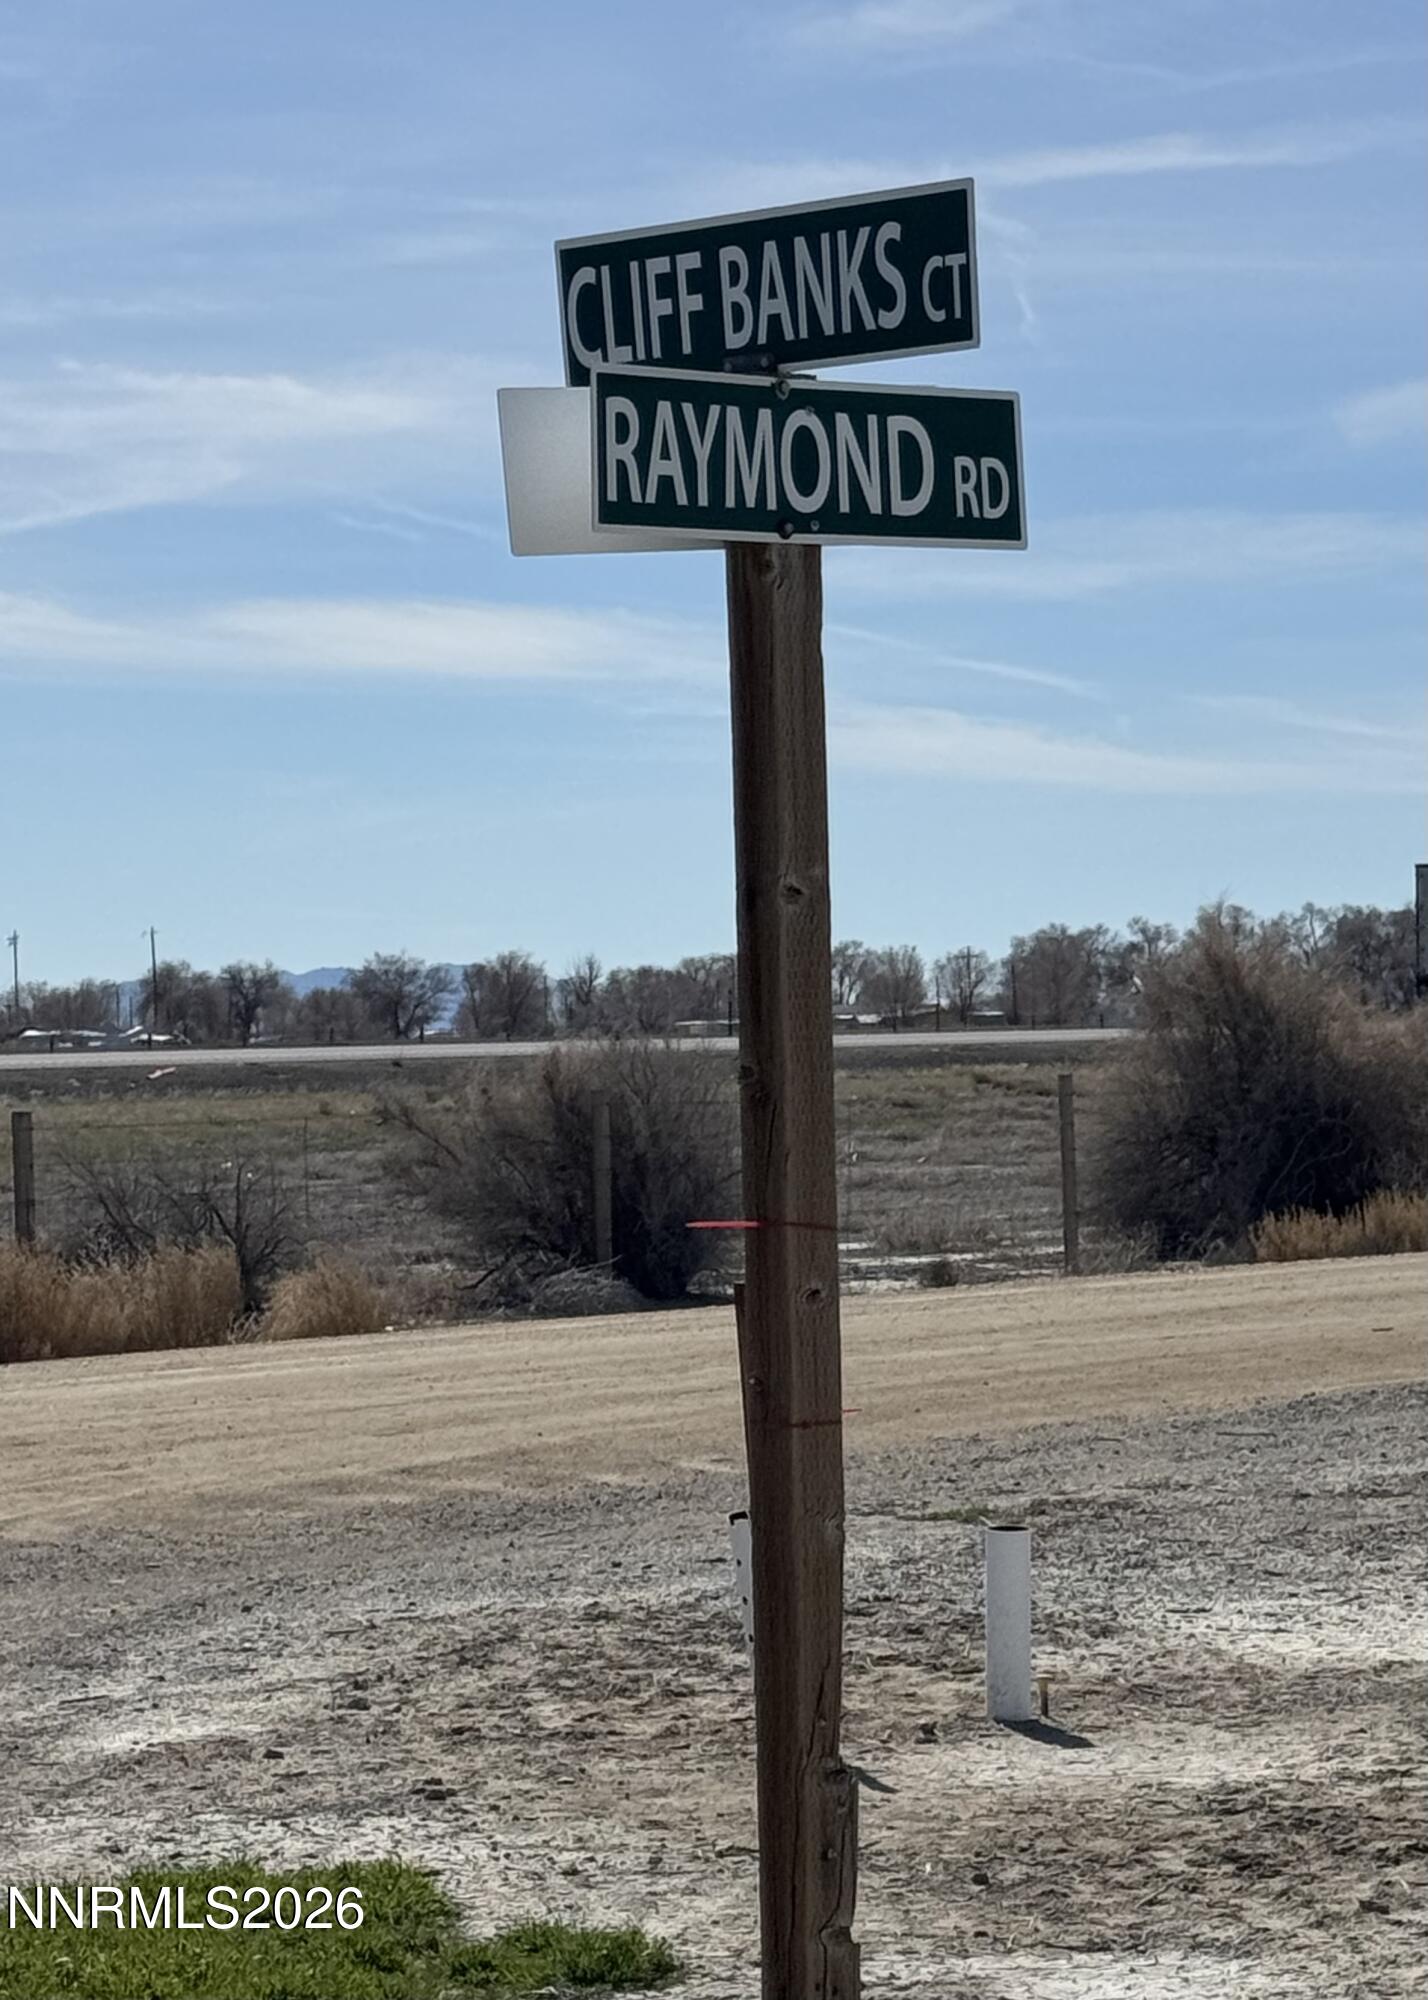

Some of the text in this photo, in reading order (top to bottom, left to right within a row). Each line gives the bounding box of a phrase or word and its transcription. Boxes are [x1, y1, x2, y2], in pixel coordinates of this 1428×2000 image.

[566, 220, 967, 368] CLIFF BANKS CT
[604, 395, 1010, 520] RAYMOND RD
